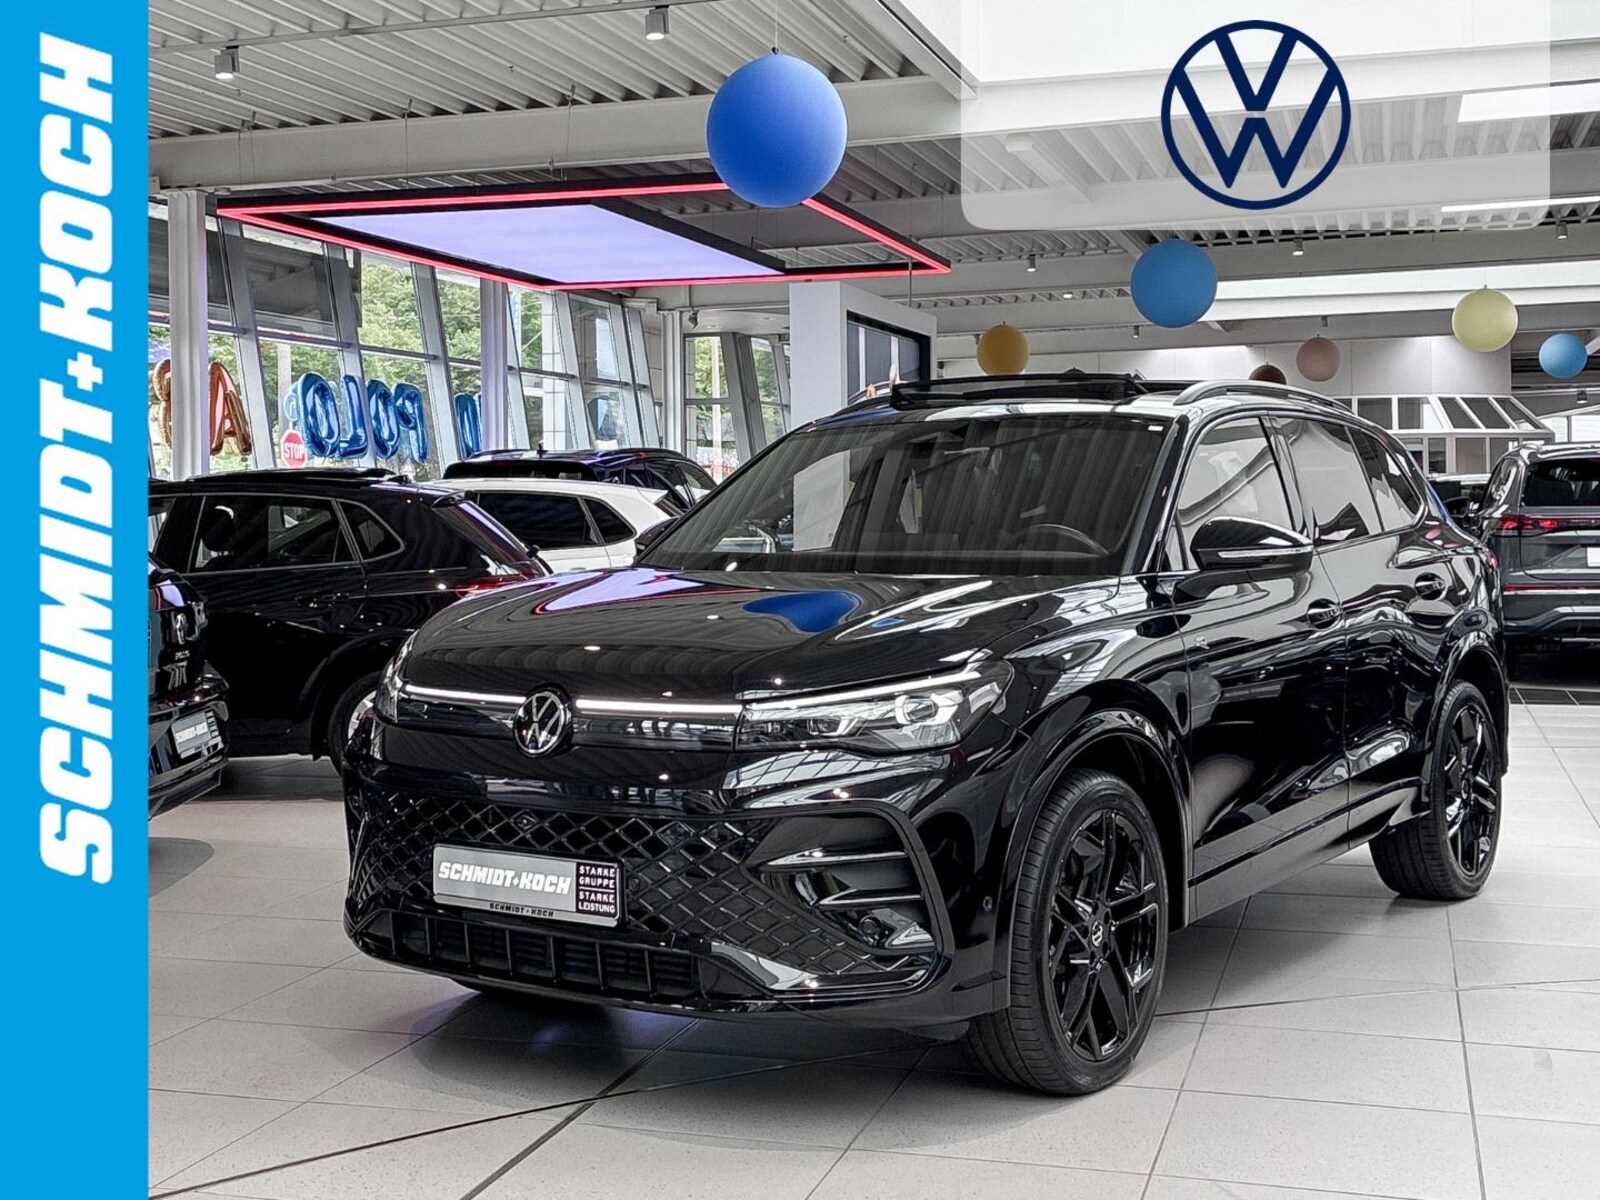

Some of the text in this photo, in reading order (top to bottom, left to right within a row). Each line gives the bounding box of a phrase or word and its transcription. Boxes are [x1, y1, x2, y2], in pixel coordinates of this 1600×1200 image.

[284, 442, 305, 460] STOP
[438, 861, 572, 895] SCHMIDT+KOCH
[579, 865, 615, 878] STARKE
[579, 876, 615, 889] GRUPPE
[579, 891, 615, 903] STARKE
[578, 901, 616, 913] LEISTUNG
